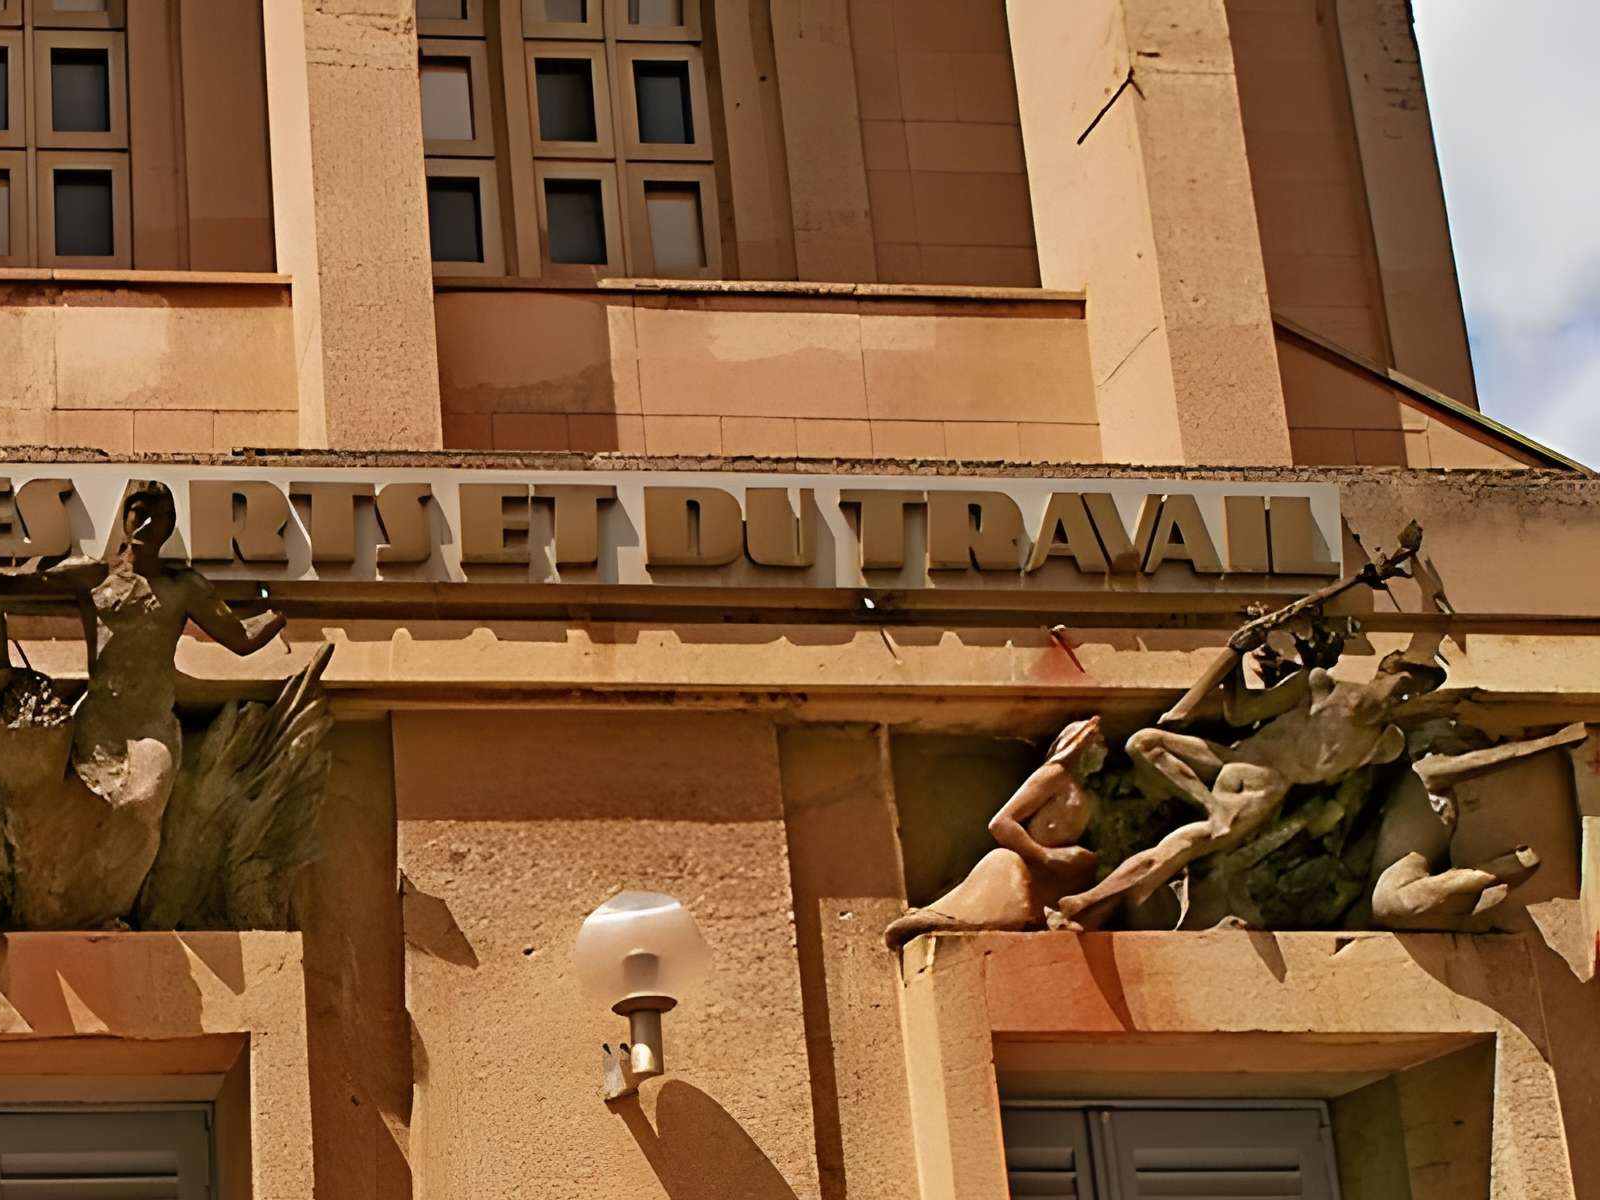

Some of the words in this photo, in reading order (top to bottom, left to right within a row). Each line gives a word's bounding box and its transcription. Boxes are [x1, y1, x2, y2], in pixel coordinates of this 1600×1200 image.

[459, 483, 618, 567] ET
[643, 486, 815, 569] DU
[839, 489, 1340, 575] TRAVAIL
